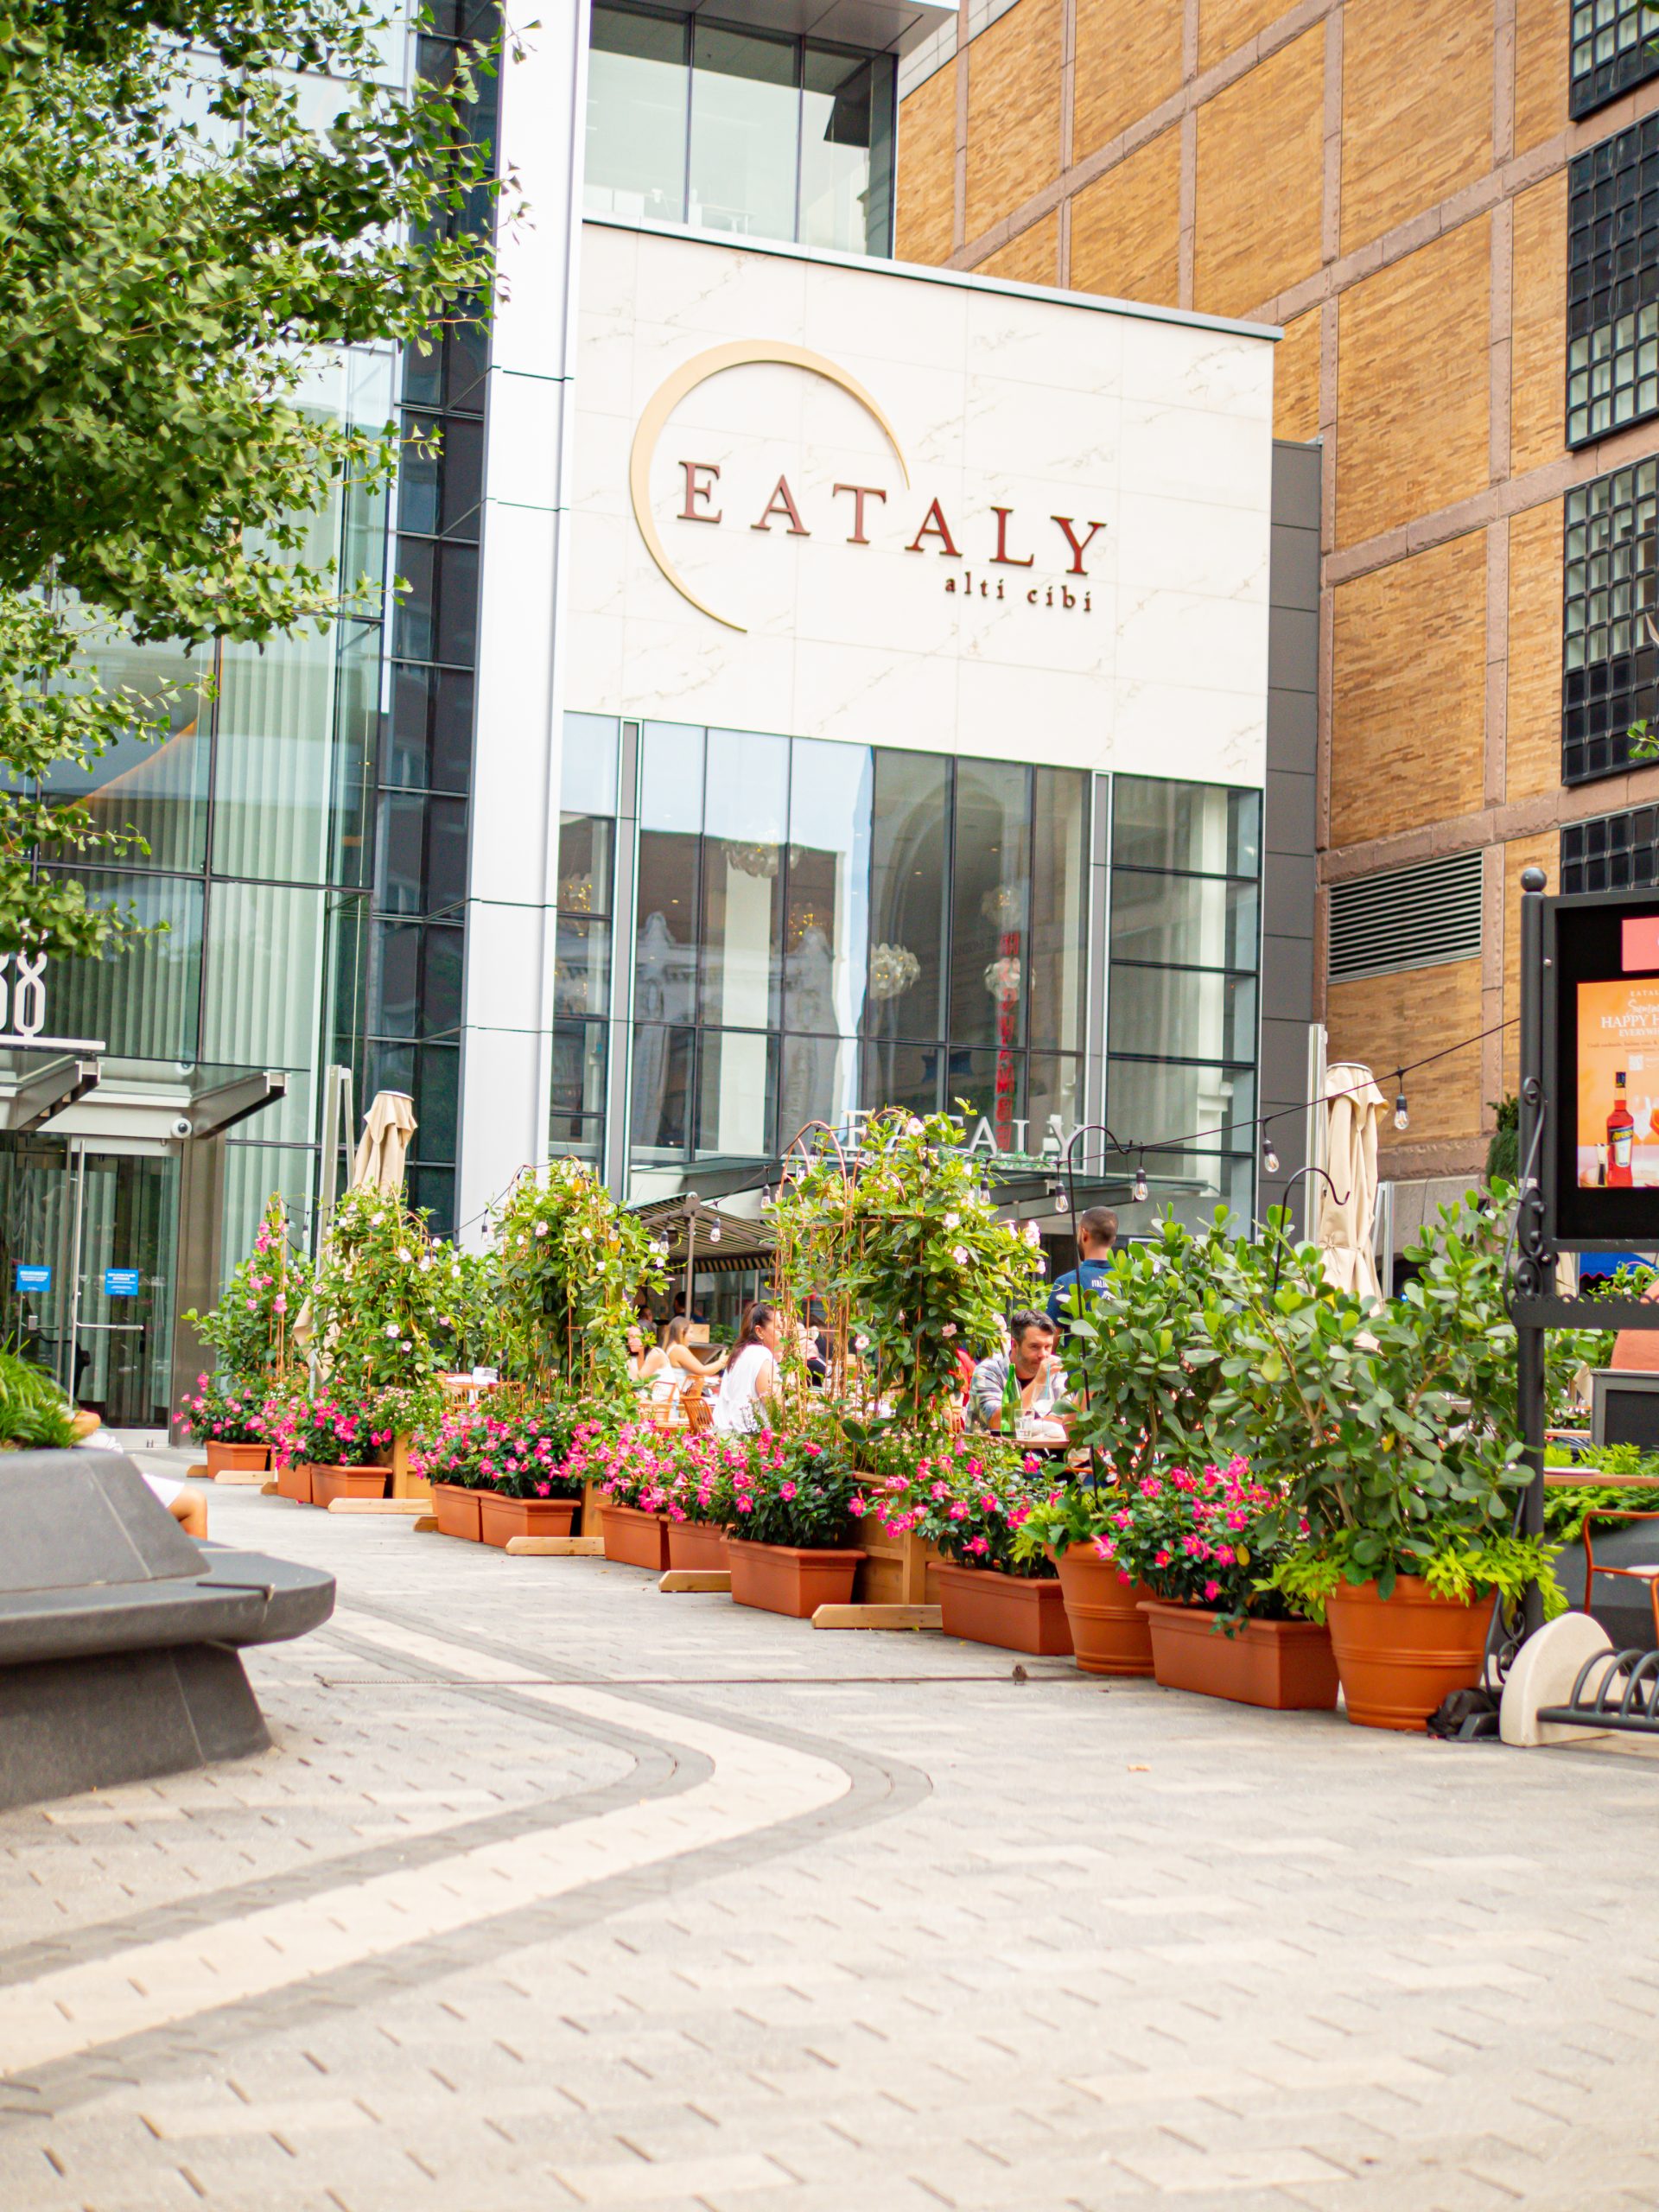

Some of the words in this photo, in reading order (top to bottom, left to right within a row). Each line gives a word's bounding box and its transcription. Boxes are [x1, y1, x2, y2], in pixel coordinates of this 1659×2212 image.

[677, 460, 1108, 575] EATALY
[944, 571, 1006, 601] alti
[1027, 585, 1092, 613] cibi
[1600, 1014, 1646, 1029] HAPPY
